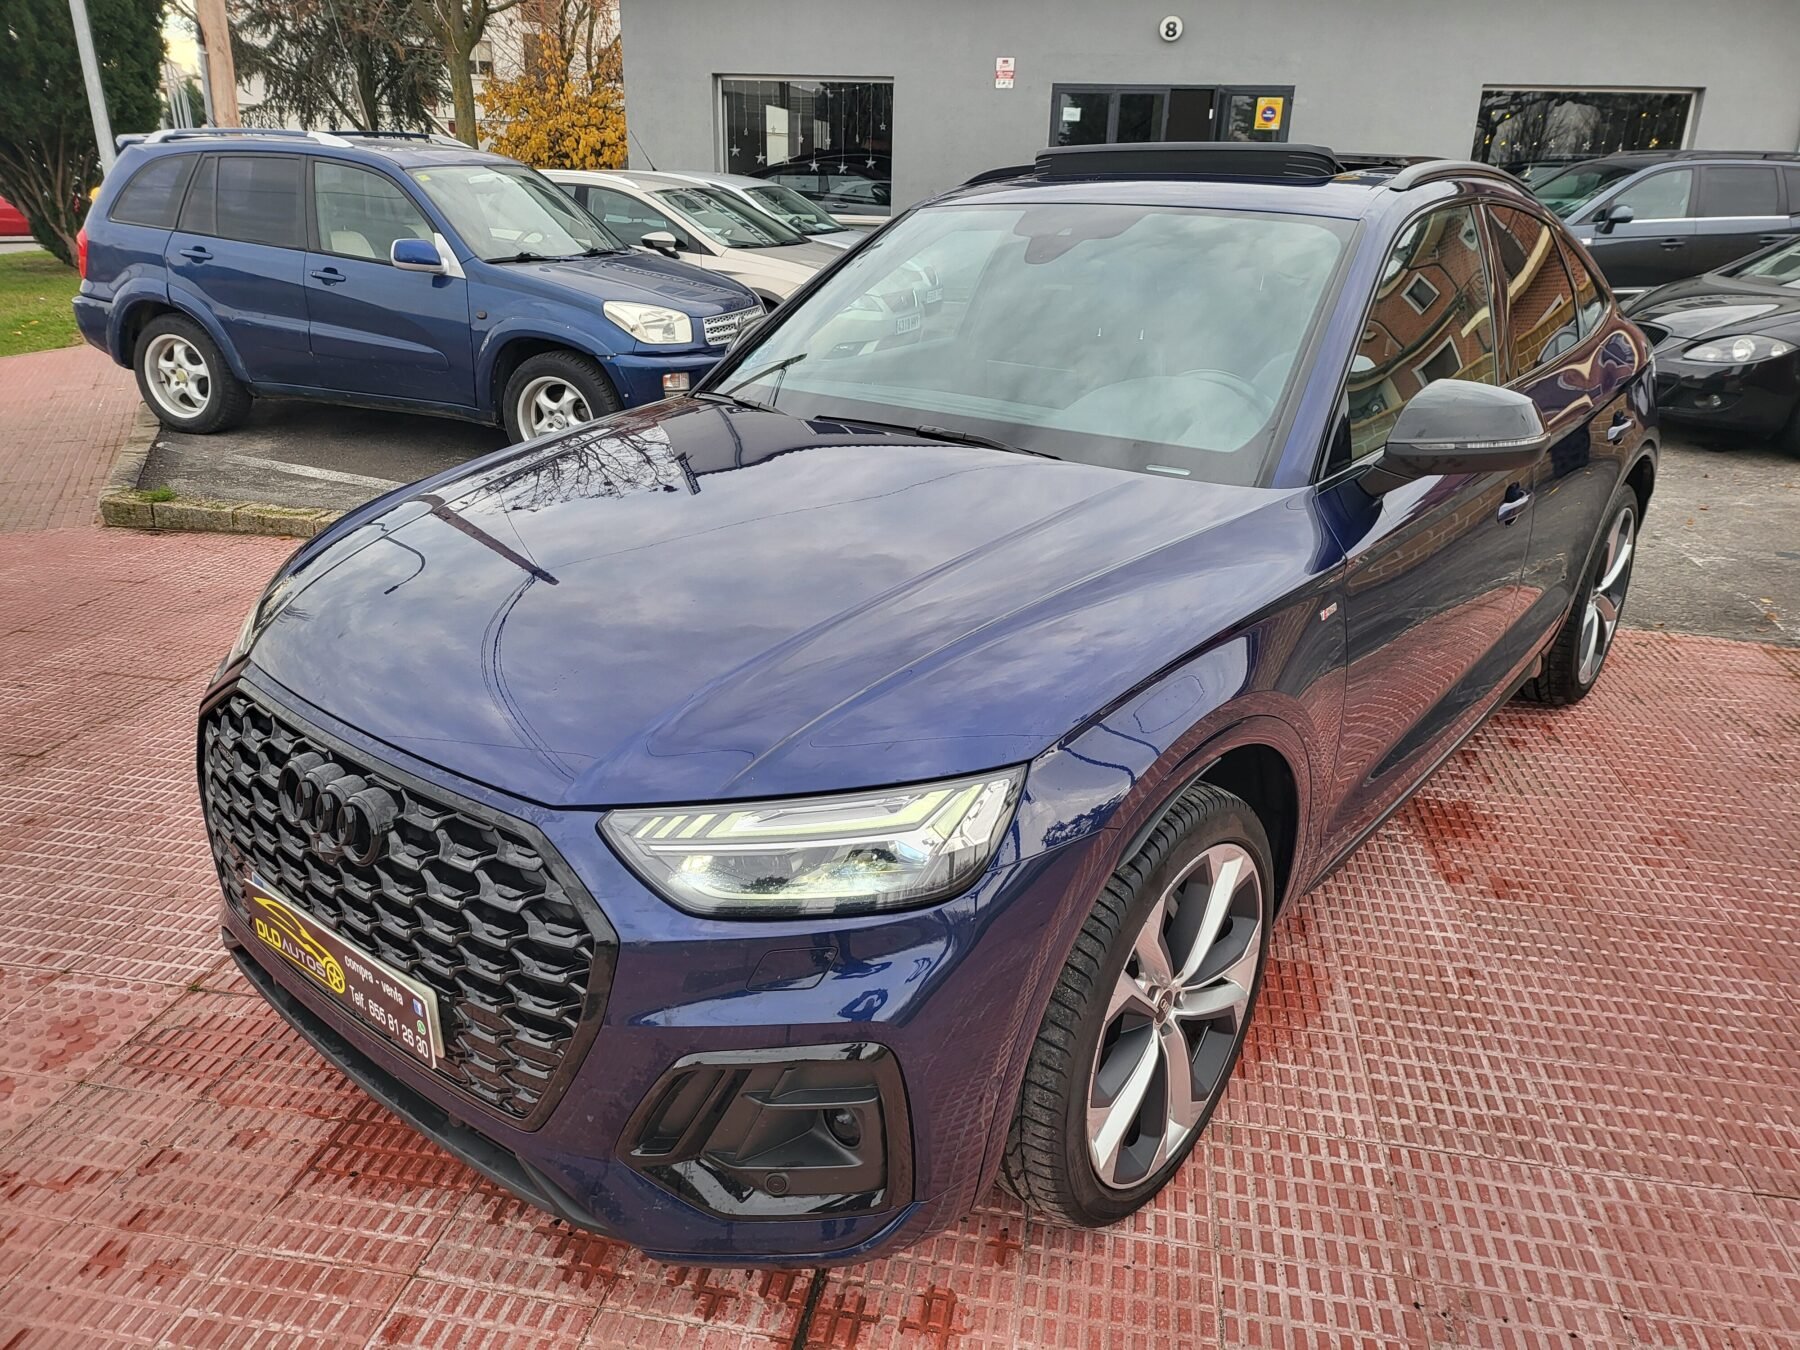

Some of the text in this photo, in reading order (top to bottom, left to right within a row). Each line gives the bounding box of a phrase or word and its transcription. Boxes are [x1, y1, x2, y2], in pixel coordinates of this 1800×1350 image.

[1165, 21, 1177, 37] 8
[344, 955, 374, 983] compra
[381, 981, 403, 1006] venta
[349, 985, 429, 1059] Telf. 655 81 26 30
